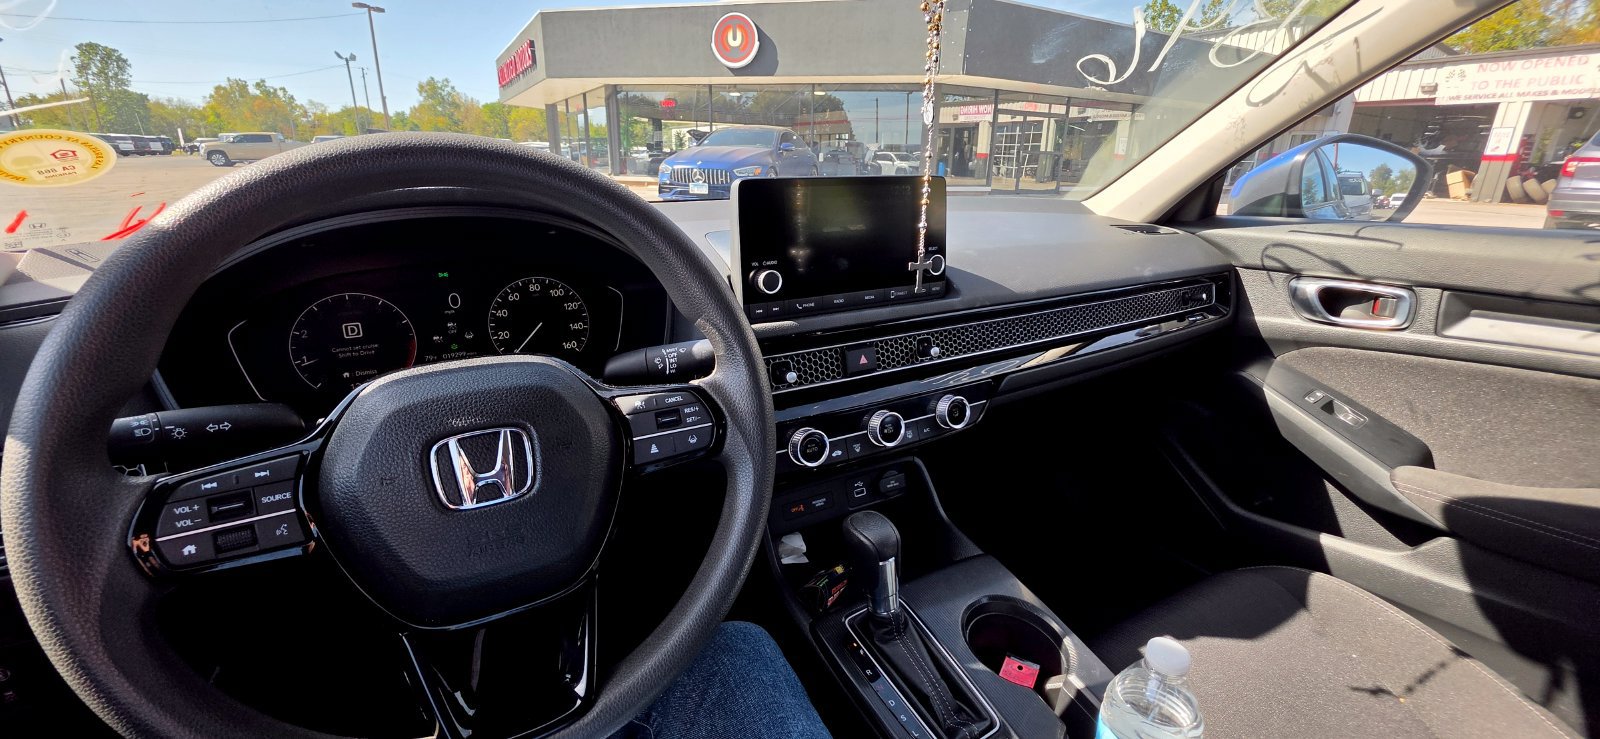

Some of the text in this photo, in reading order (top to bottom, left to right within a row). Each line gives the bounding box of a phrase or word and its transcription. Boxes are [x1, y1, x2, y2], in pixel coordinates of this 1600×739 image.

[1477, 55, 1589, 73] NOW OPENED
[1472, 74, 1585, 90] TO THE PUBLIC
[1463, 92, 1496, 100] SERVICE
[529, 283, 541, 292] 80
[508, 292, 520, 302] 60
[550, 288, 565, 297] 100
[449, 292, 461, 309] 0
[564, 302, 579, 311] 120
[496, 309, 508, 318] 40
[569, 323, 584, 331] 140
[300, 330, 309, 339] 2
[498, 331, 510, 340] 20
[563, 341, 577, 350] 160
[665, 395, 683, 404] CANCEL
[261, 491, 292, 504] SOURCE
[888, 699, 896, 707] D
[900, 714, 907, 722] S
